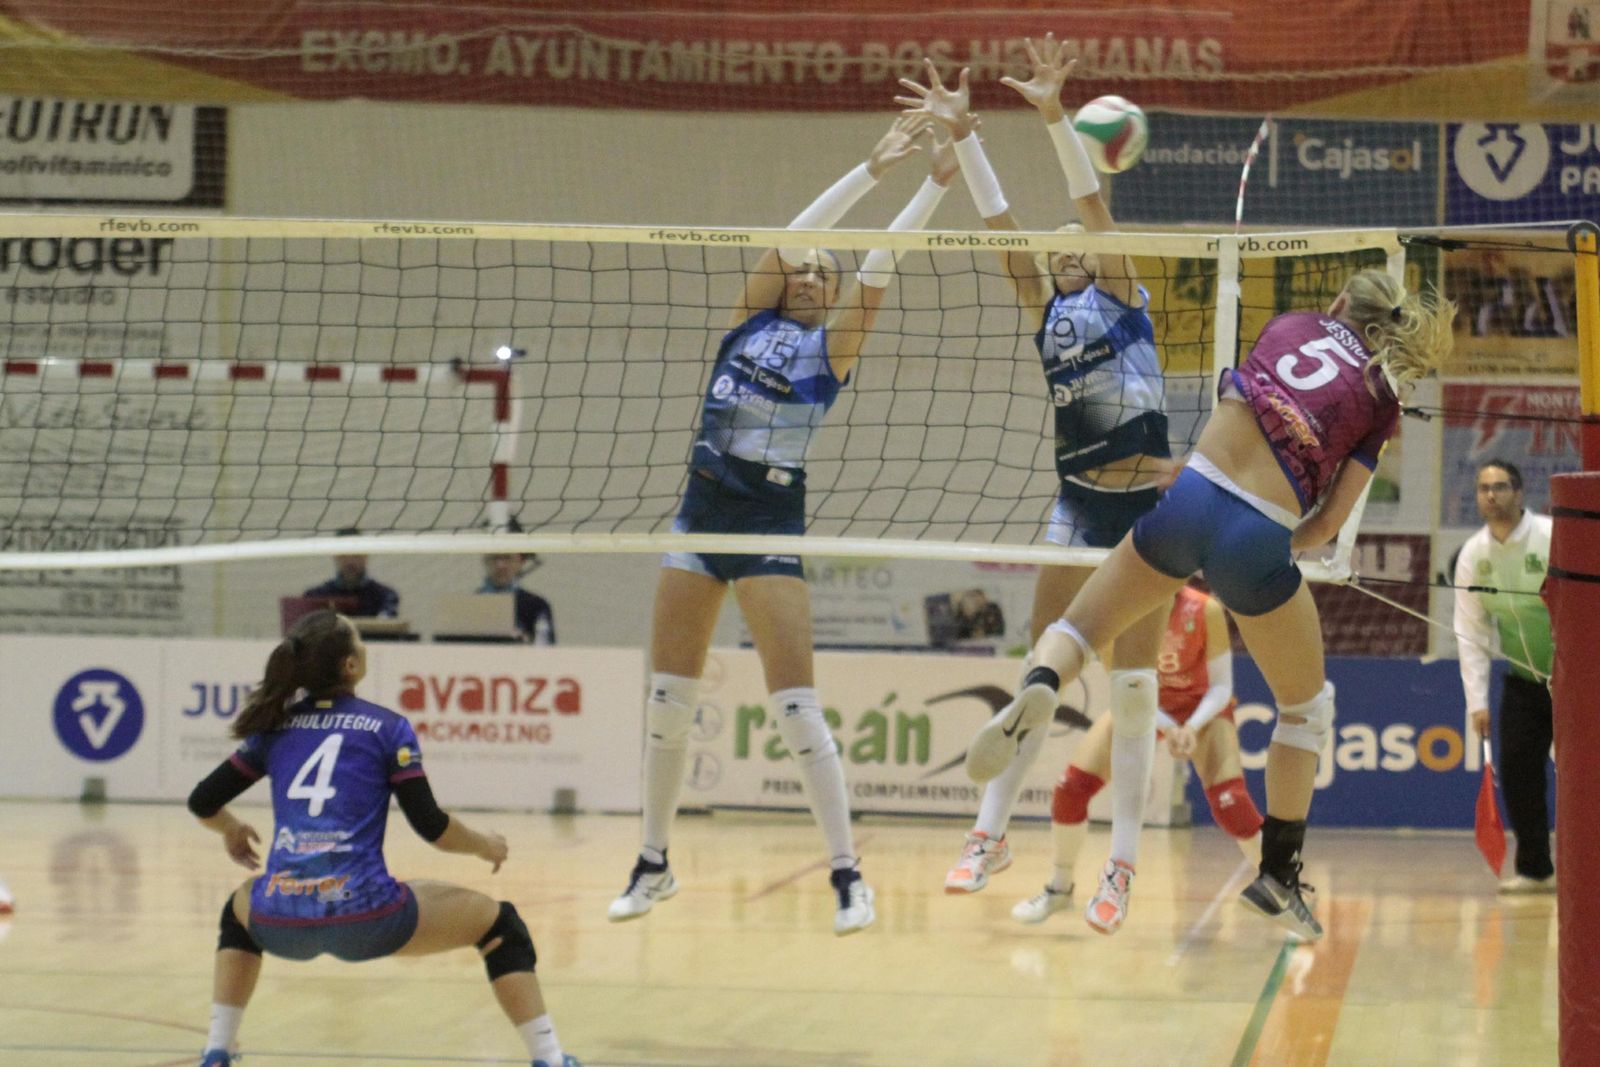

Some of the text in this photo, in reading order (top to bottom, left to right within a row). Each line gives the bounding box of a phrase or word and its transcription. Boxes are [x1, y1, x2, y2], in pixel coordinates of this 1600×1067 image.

[301, 30, 471, 76] EXCMO.
[485, 34, 846, 85] AYUNTAMIENTO
[861, 40, 955, 82] DOS
[0, 99, 172, 145] UTRON
[0, 155, 173, 177] olivitaminico
[1143, 143, 1254, 165] undació
[1299, 136, 1421, 179] Cajasol
[100, 219, 200, 233] rfevb.com
[373, 222, 475, 236] rfevb.com
[648, 229, 751, 243] rfevb.com
[926, 233, 1029, 247] rfevb.com
[1207, 237, 1309, 252] rfvb.com
[1052, 316, 1078, 349] 9
[756, 338, 796, 370] 15
[1275, 335, 1361, 391] 5
[399, 674, 582, 715] avanza
[414, 722, 553, 743] ACKAGING
[1231, 703, 1480, 790] Cjasol
[286, 732, 344, 818] 4
[854, 782, 979, 803] COMPLEMENTOS
